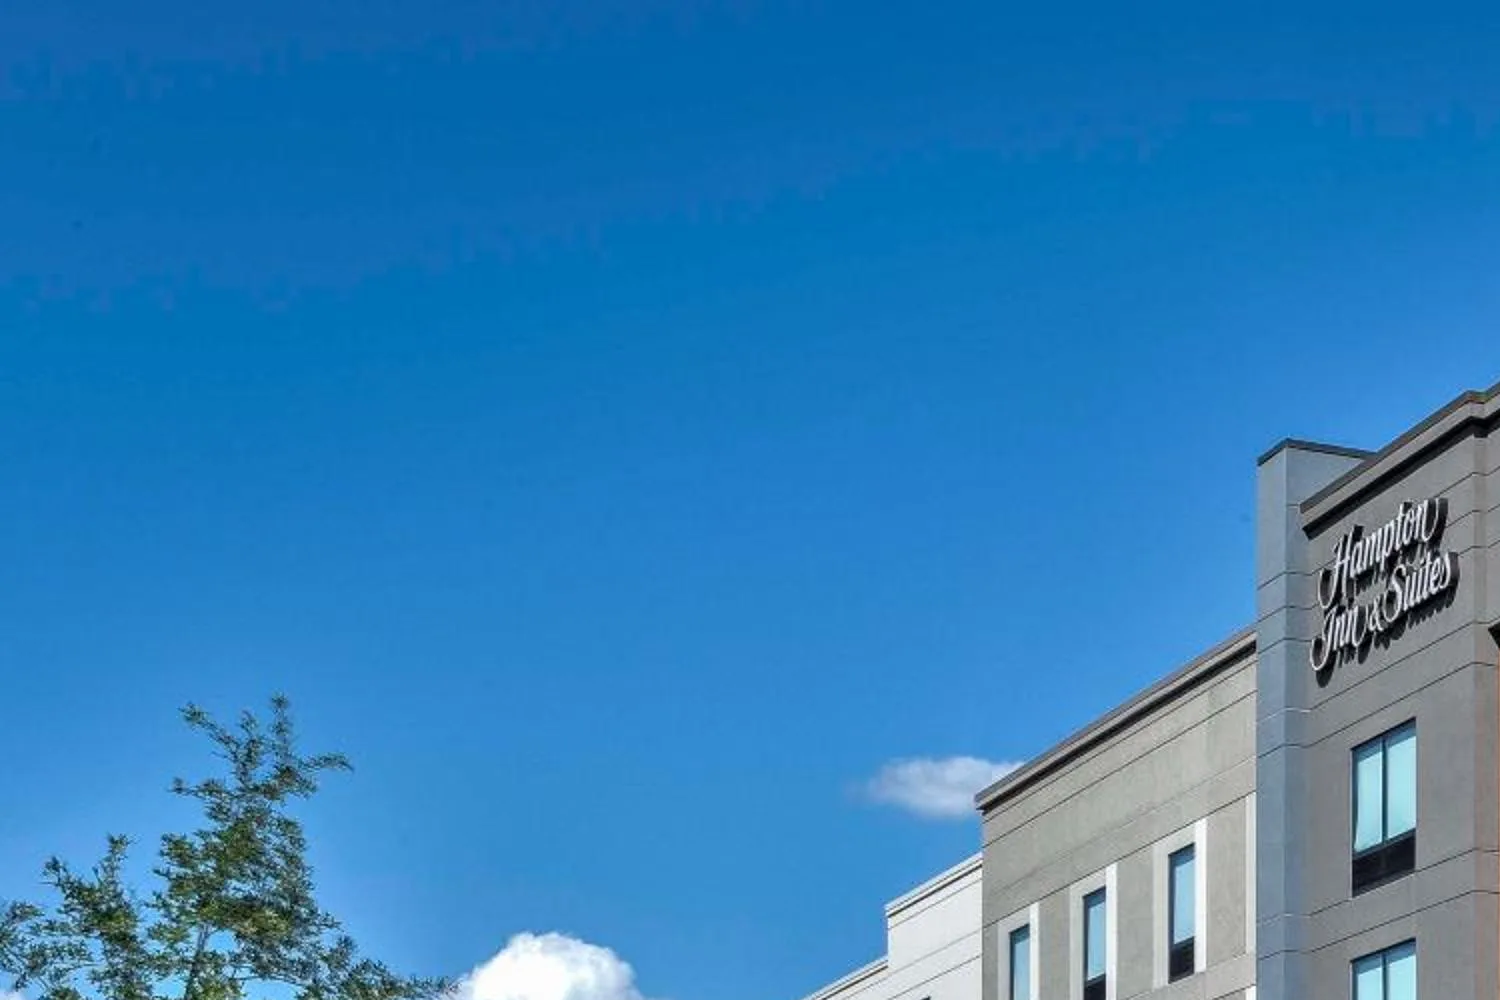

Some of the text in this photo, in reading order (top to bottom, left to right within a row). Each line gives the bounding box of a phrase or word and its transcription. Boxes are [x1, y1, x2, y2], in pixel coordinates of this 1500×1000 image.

[1318, 499, 1440, 609] Hampton
[1310, 606, 1369, 671] Inn
[1383, 552, 1451, 622] Suites
